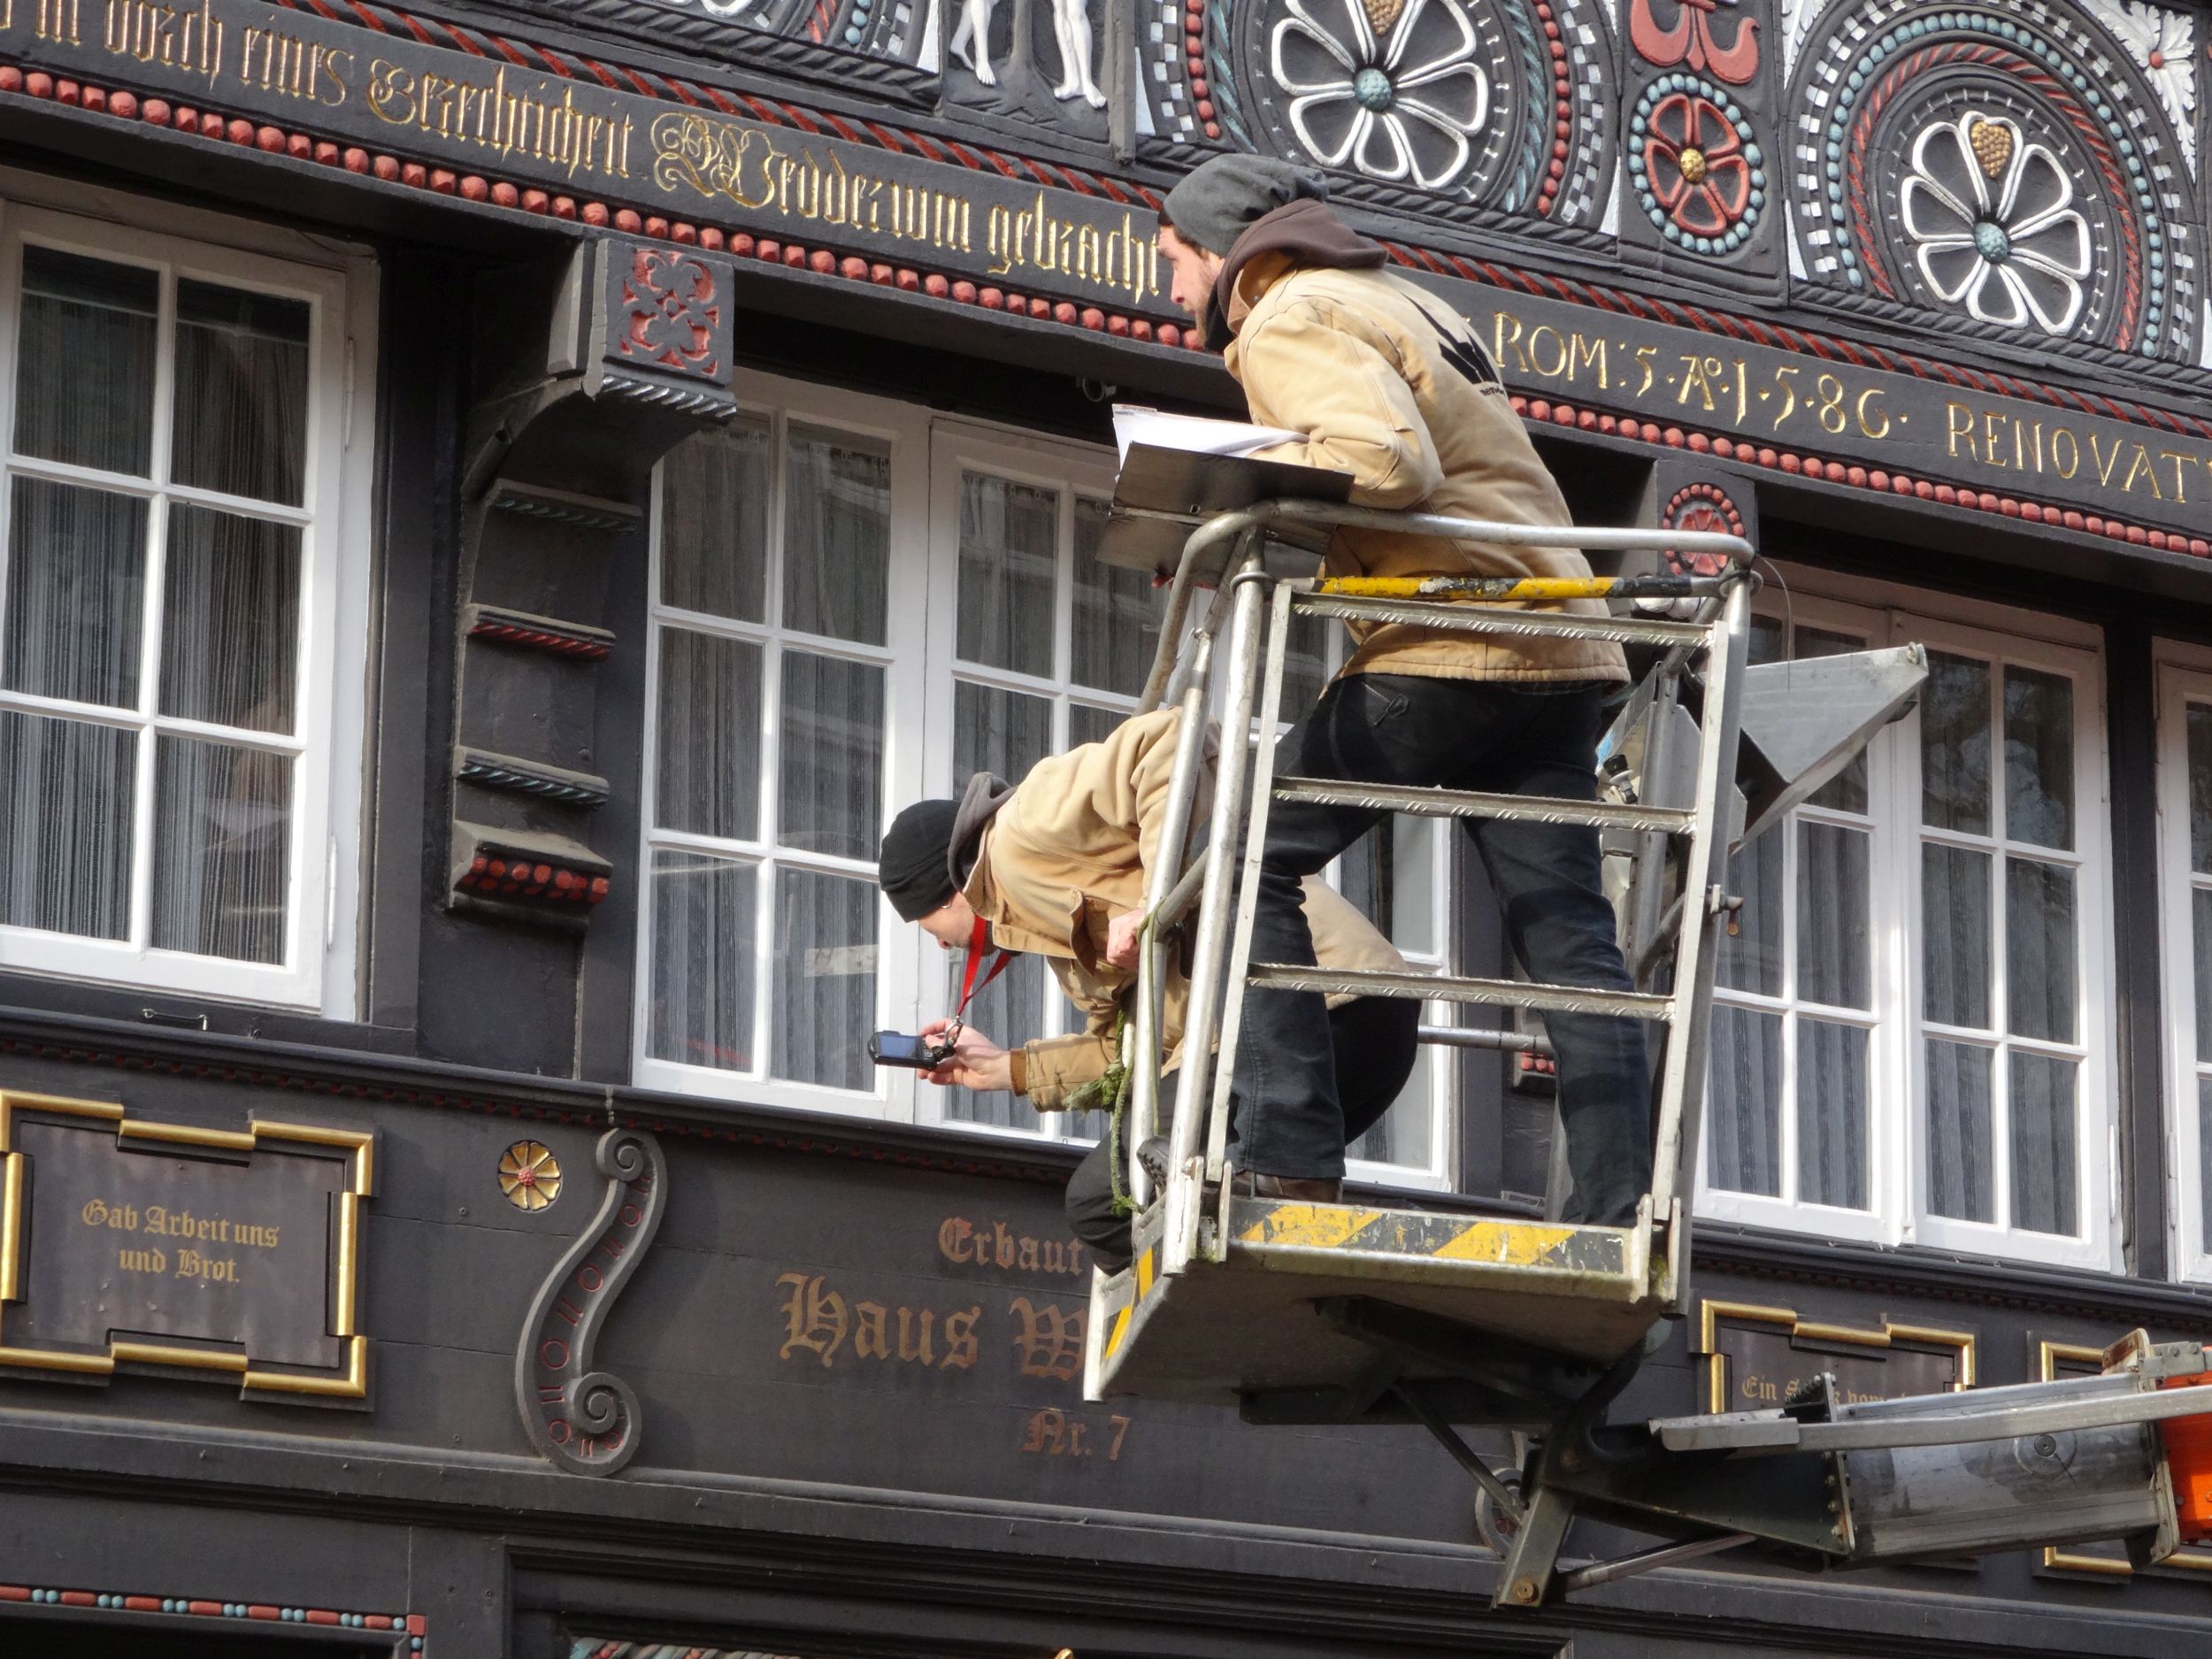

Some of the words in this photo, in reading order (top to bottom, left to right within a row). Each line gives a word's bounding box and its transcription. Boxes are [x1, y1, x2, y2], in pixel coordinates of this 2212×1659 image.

[1946, 402, 2212, 503] RENOVAT
[81, 1198, 137, 1231] Gab
[144, 1204, 230, 1242] Arbeit
[234, 1223, 280, 1248] uns
[938, 1217, 1084, 1276] Erbaut
[119, 1247, 167, 1274] und
[175, 1248, 241, 1283] Brot.
[774, 1272, 981, 1371] Haus
[1741, 1375, 1778, 1402] Ein
[1019, 1408, 1092, 1457] Nr.
[1106, 1416, 1131, 1461] 7
